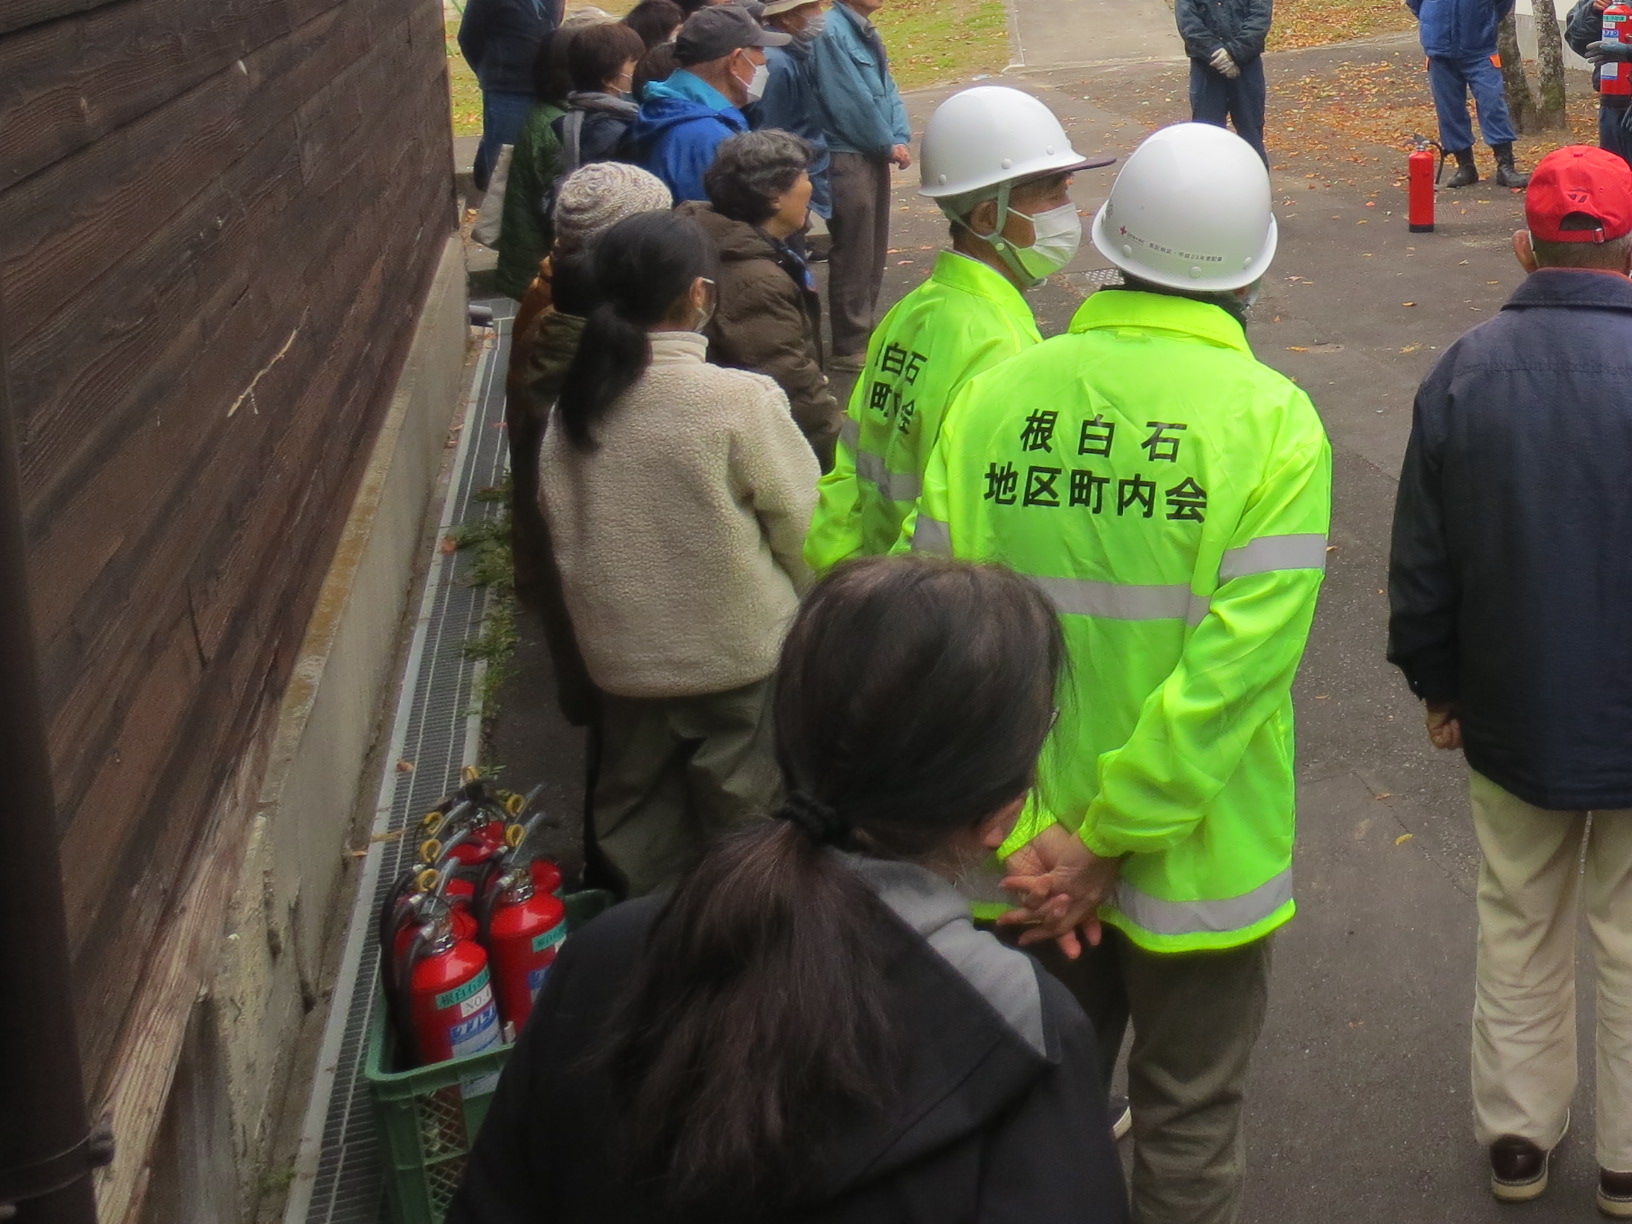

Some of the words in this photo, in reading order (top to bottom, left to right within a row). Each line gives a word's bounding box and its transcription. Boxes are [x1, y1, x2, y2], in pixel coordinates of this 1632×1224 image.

[875, 341, 928, 386] 白石
[1020, 408, 1188, 463] 根白石
[983, 461, 1208, 524] 地区町内会
